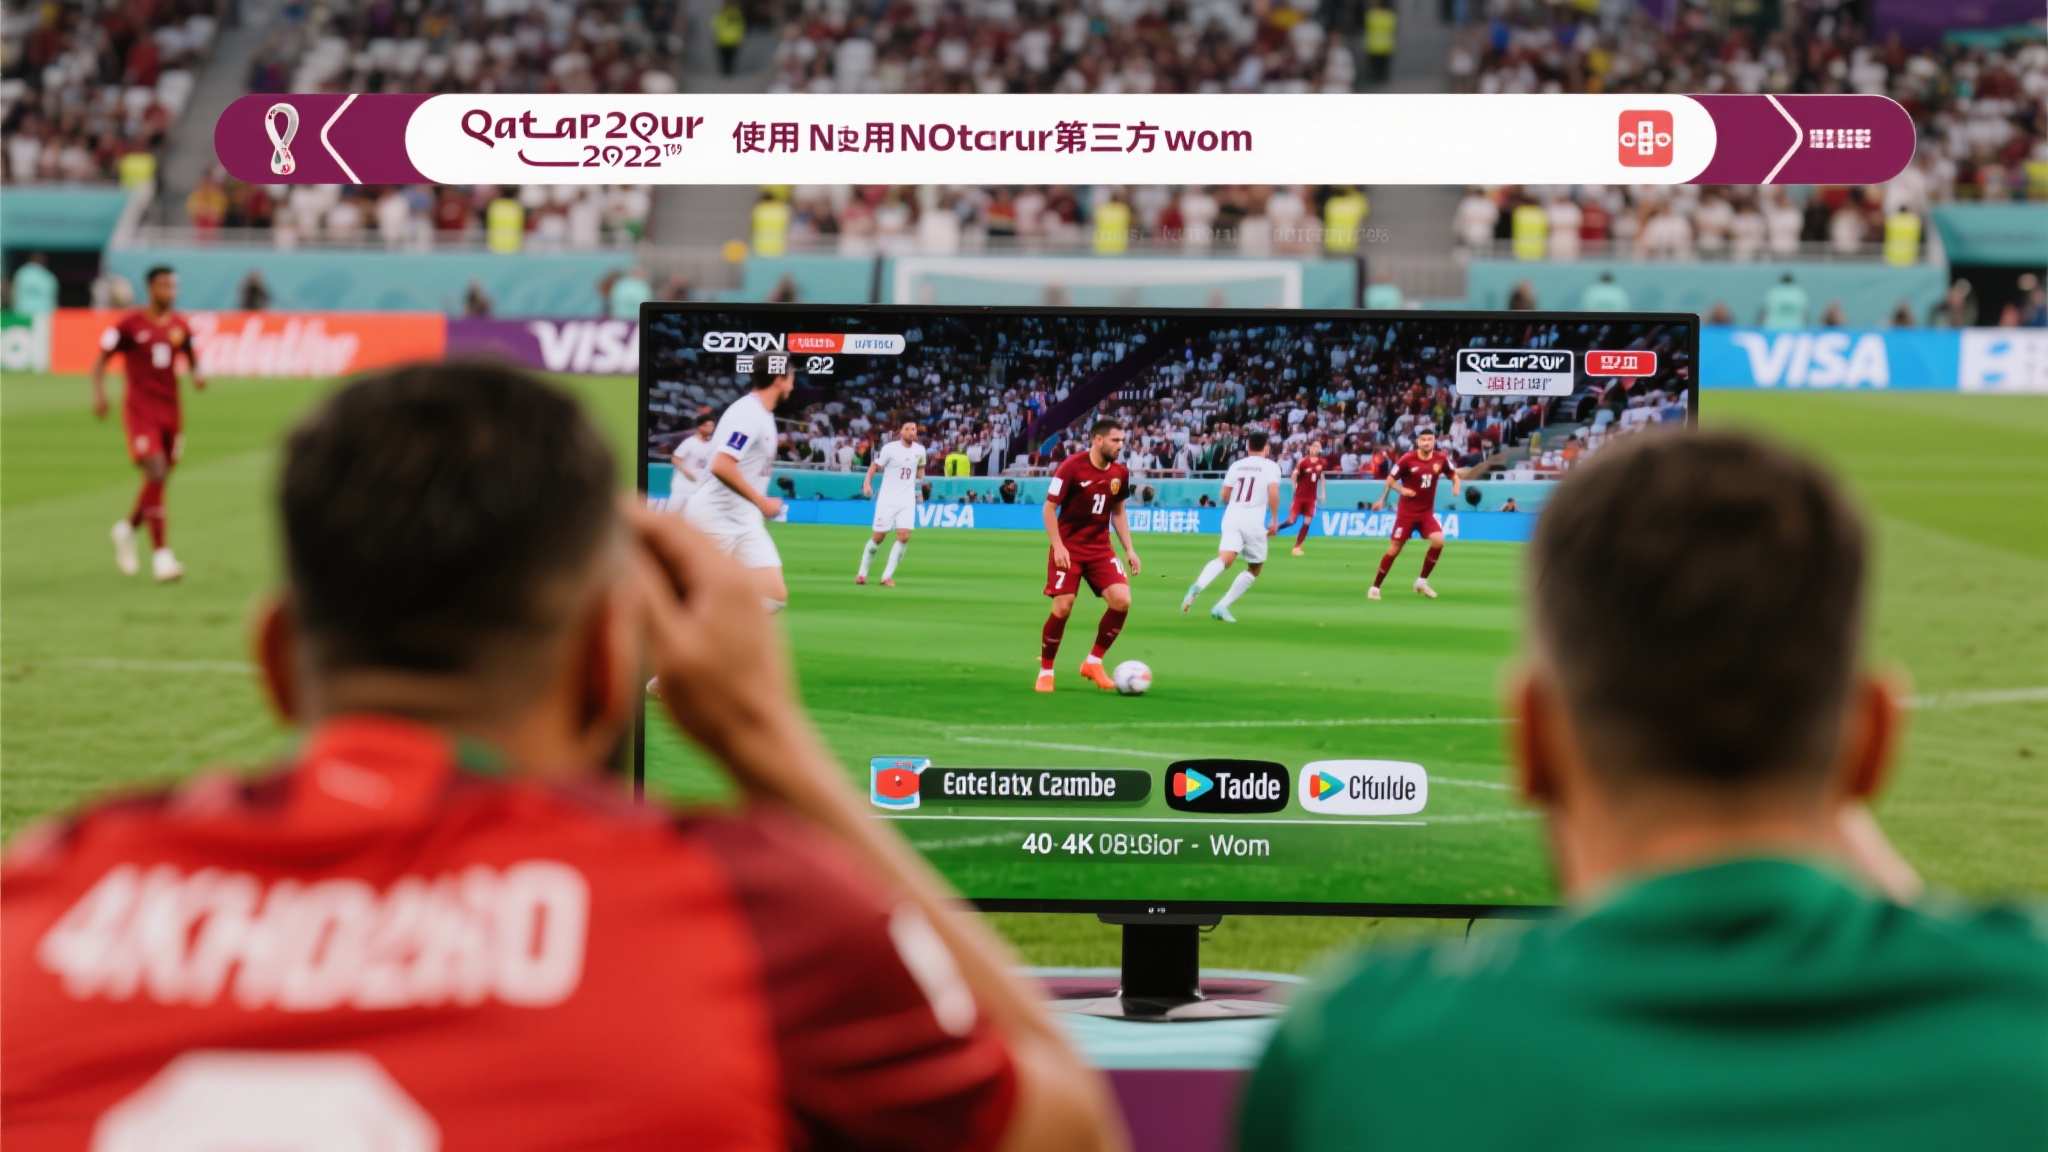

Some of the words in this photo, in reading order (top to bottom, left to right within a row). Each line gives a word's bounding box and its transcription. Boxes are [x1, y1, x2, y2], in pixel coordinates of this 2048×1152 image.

[527, 320, 640, 372] VIS
[1731, 331, 1890, 387] VISA
[916, 503, 974, 528] VISA
[1216, 772, 1281, 800] Tadde
[1209, 833, 1270, 857] Wom
